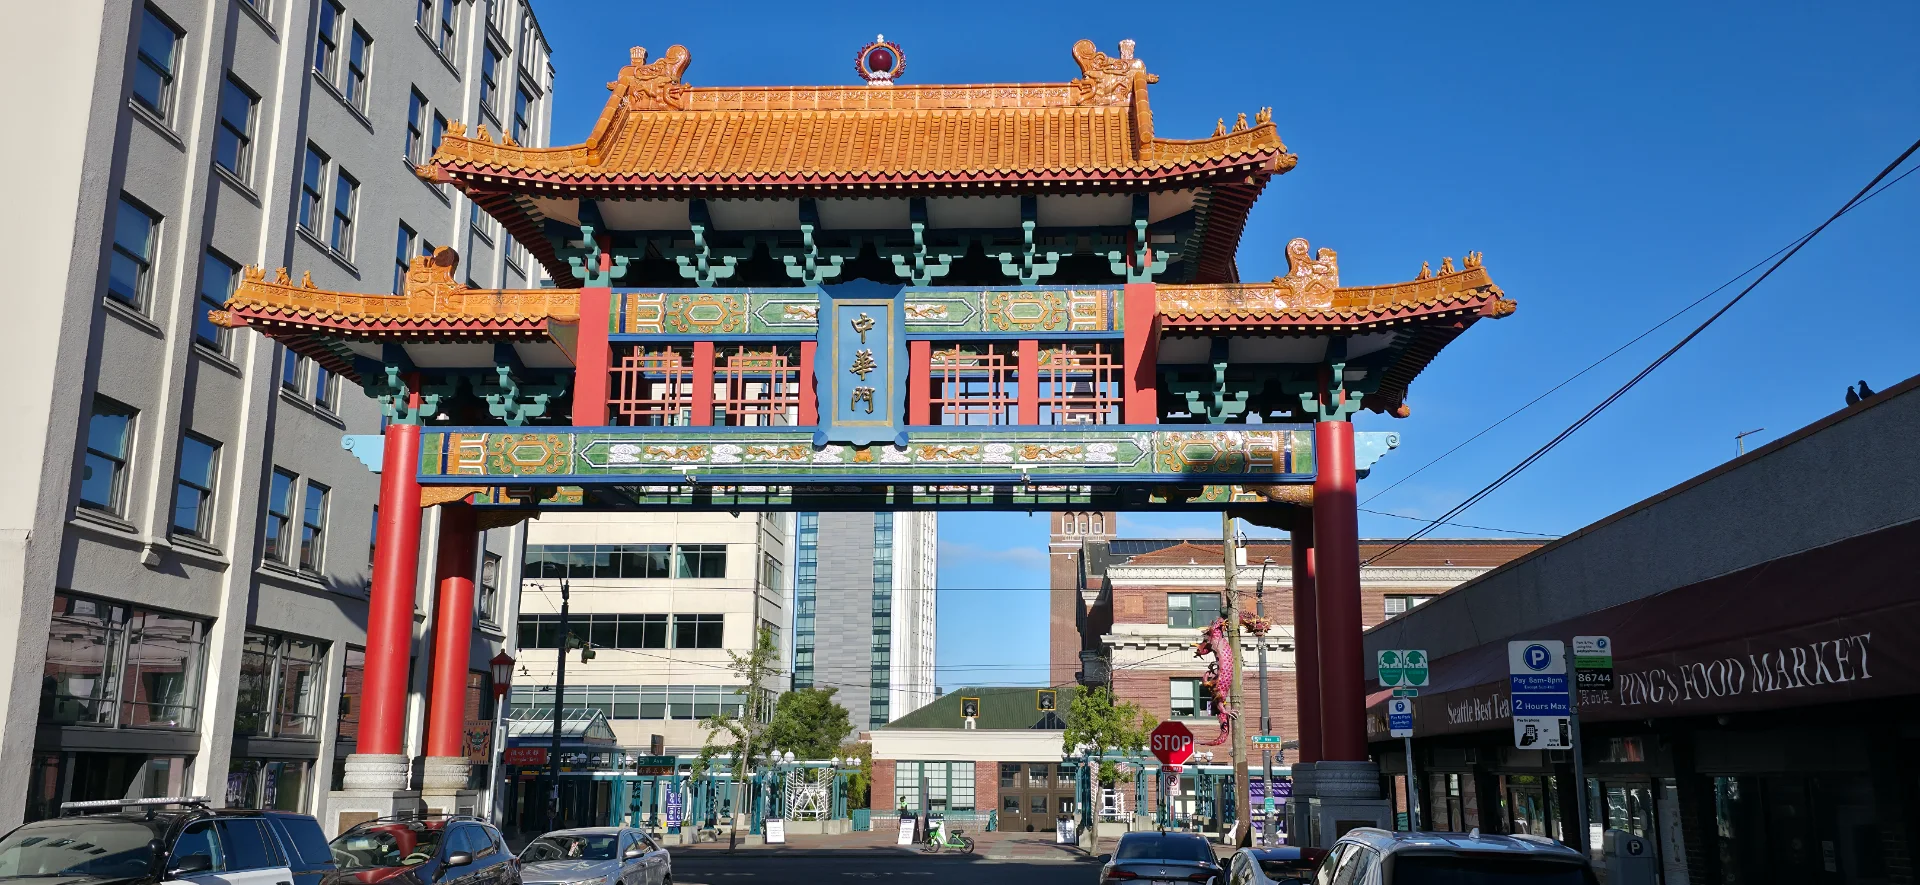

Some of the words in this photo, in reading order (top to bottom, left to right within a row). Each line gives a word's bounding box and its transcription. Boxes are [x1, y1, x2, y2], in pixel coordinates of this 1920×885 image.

[849, 312, 877, 414] 中華門
[1531, 650, 1545, 666] P
[1620, 669, 1678, 705] PING'S
[1680, 656, 1744, 701] FOOD
[1749, 632, 1872, 694] MARKET
[1513, 677, 1526, 685] Pay
[1528, 677, 1563, 685] 8am-8pm
[1578, 673, 1611, 682] 86744
[1448, 700, 1473, 726] Seattle
[1474, 697, 1492, 722] Best
[1492, 693, 1510, 720] Tea
[1515, 699, 1523, 710] 2
[1525, 702, 1549, 710] Hours
[1550, 702, 1567, 710] Max
[1153, 734, 1190, 751] STOP
[1631, 842, 1640, 853] P
